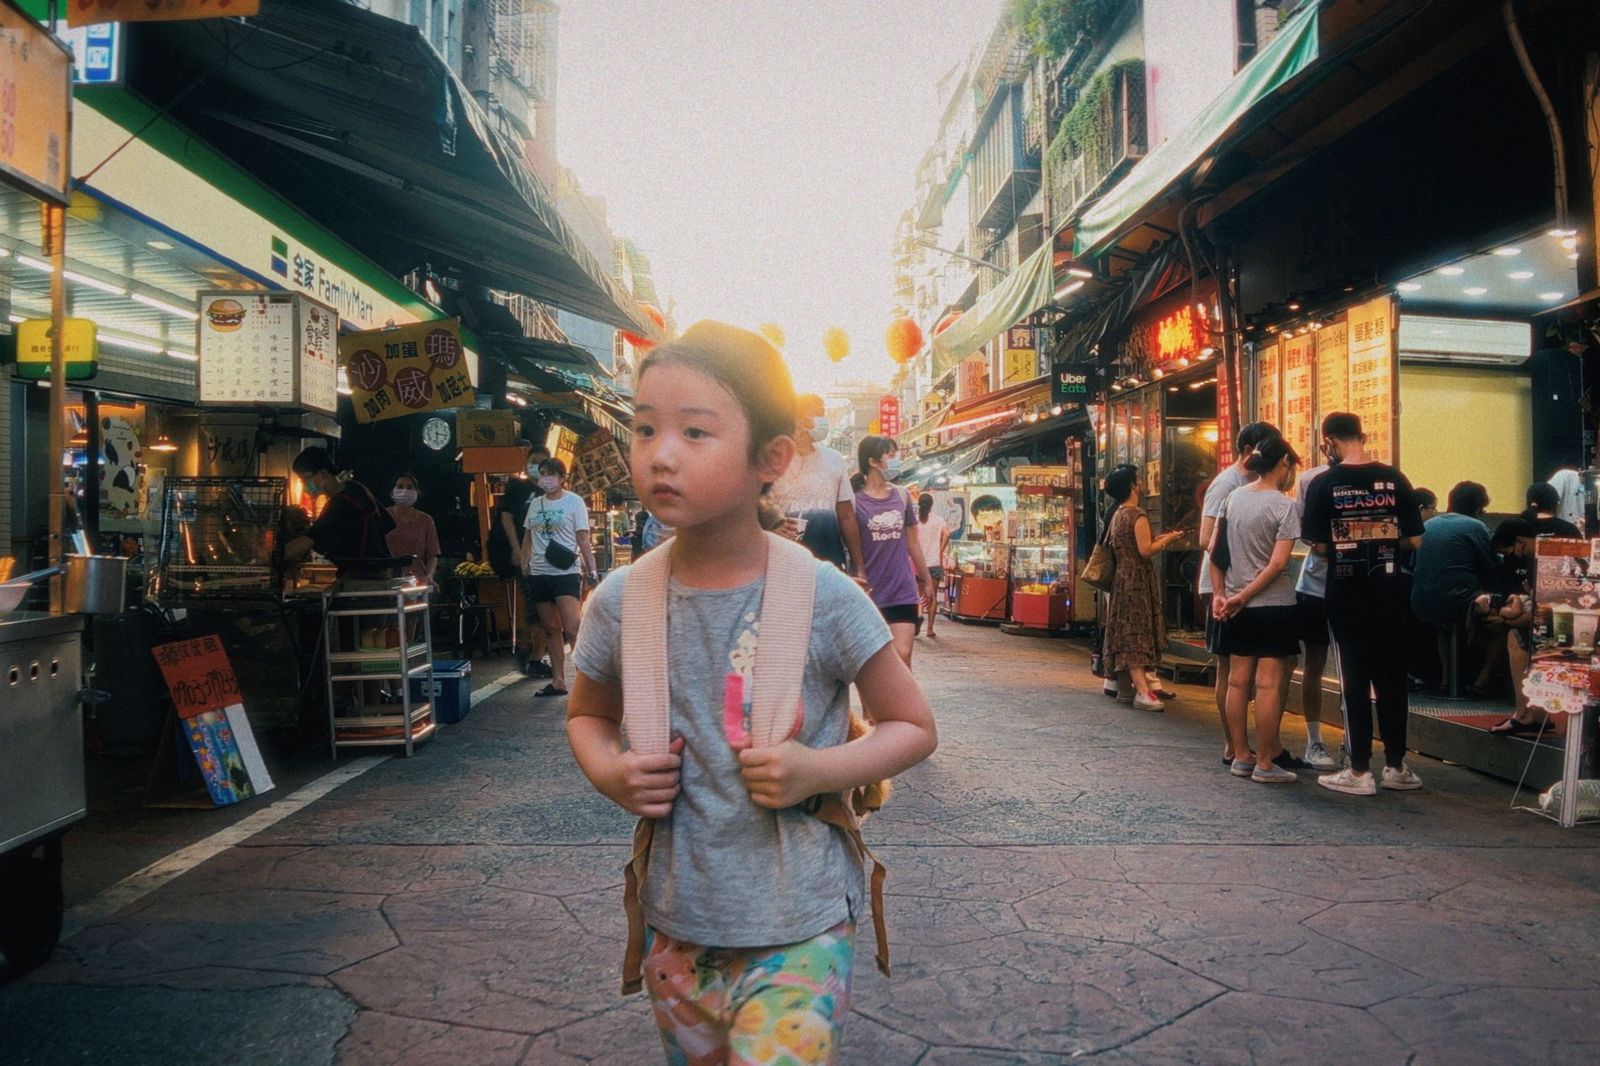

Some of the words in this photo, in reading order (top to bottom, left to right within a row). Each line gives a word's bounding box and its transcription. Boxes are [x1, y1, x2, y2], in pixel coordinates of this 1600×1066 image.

[293, 252, 315, 292] 全家
[319, 266, 374, 325] FamilyMart
[384, 341, 418, 359] 加蛋
[1060, 373, 1087, 383] Uber
[396, 371, 431, 405] 威
[1060, 384, 1087, 393] Eats
[362, 388, 392, 419] 加肉
[1333, 489, 1370, 497] BASKETBALL
[1334, 493, 1396, 509] SEASON
